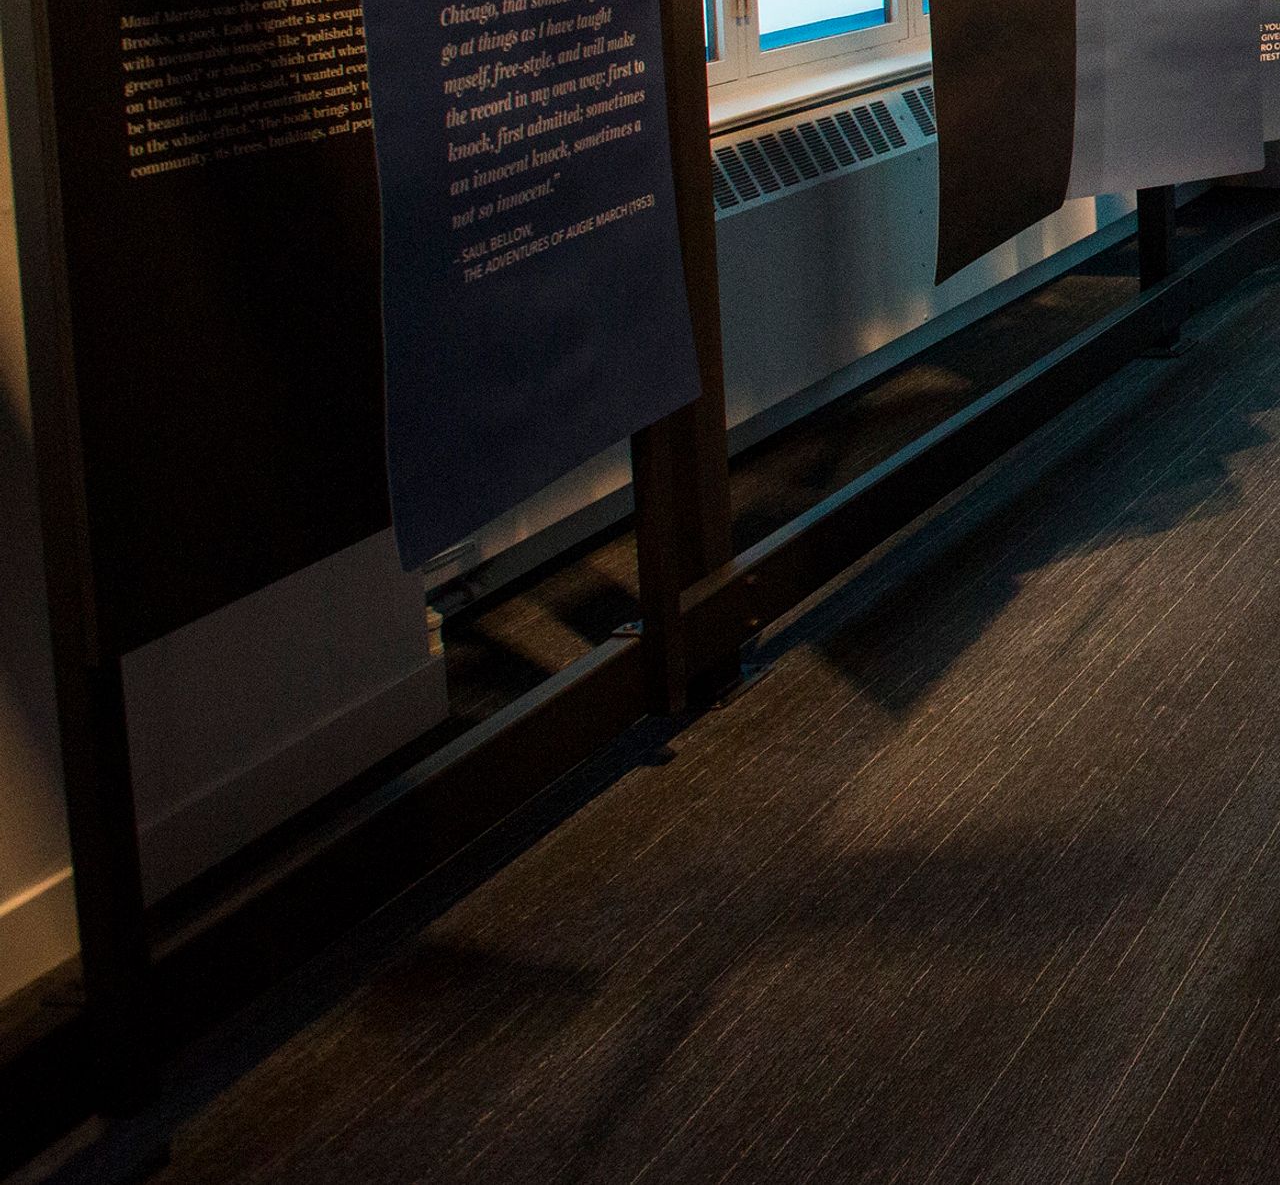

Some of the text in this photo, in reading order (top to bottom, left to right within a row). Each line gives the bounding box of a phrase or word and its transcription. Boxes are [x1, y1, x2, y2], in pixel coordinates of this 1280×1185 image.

[440, 1, 499, 26] Chicago,
[441, 7, 612, 66] go at things as have taught
[558, 44, 580, 64] and
[583, 36, 605, 57] will
[607, 30, 636, 52] make
[446, 107, 468, 128] the
[470, 92, 512, 121] record
[515, 89, 528, 108] in
[531, 85, 551, 106] my
[553, 79, 577, 97] own
[607, 62, 633, 87] first
[634, 59, 646, 75] to
[448, 132, 495, 163] knock,
[497, 122, 525, 154] first
[586, 89, 646, 118] sometimes
[473, 124, 633, 189] innocent knock, sometimes
